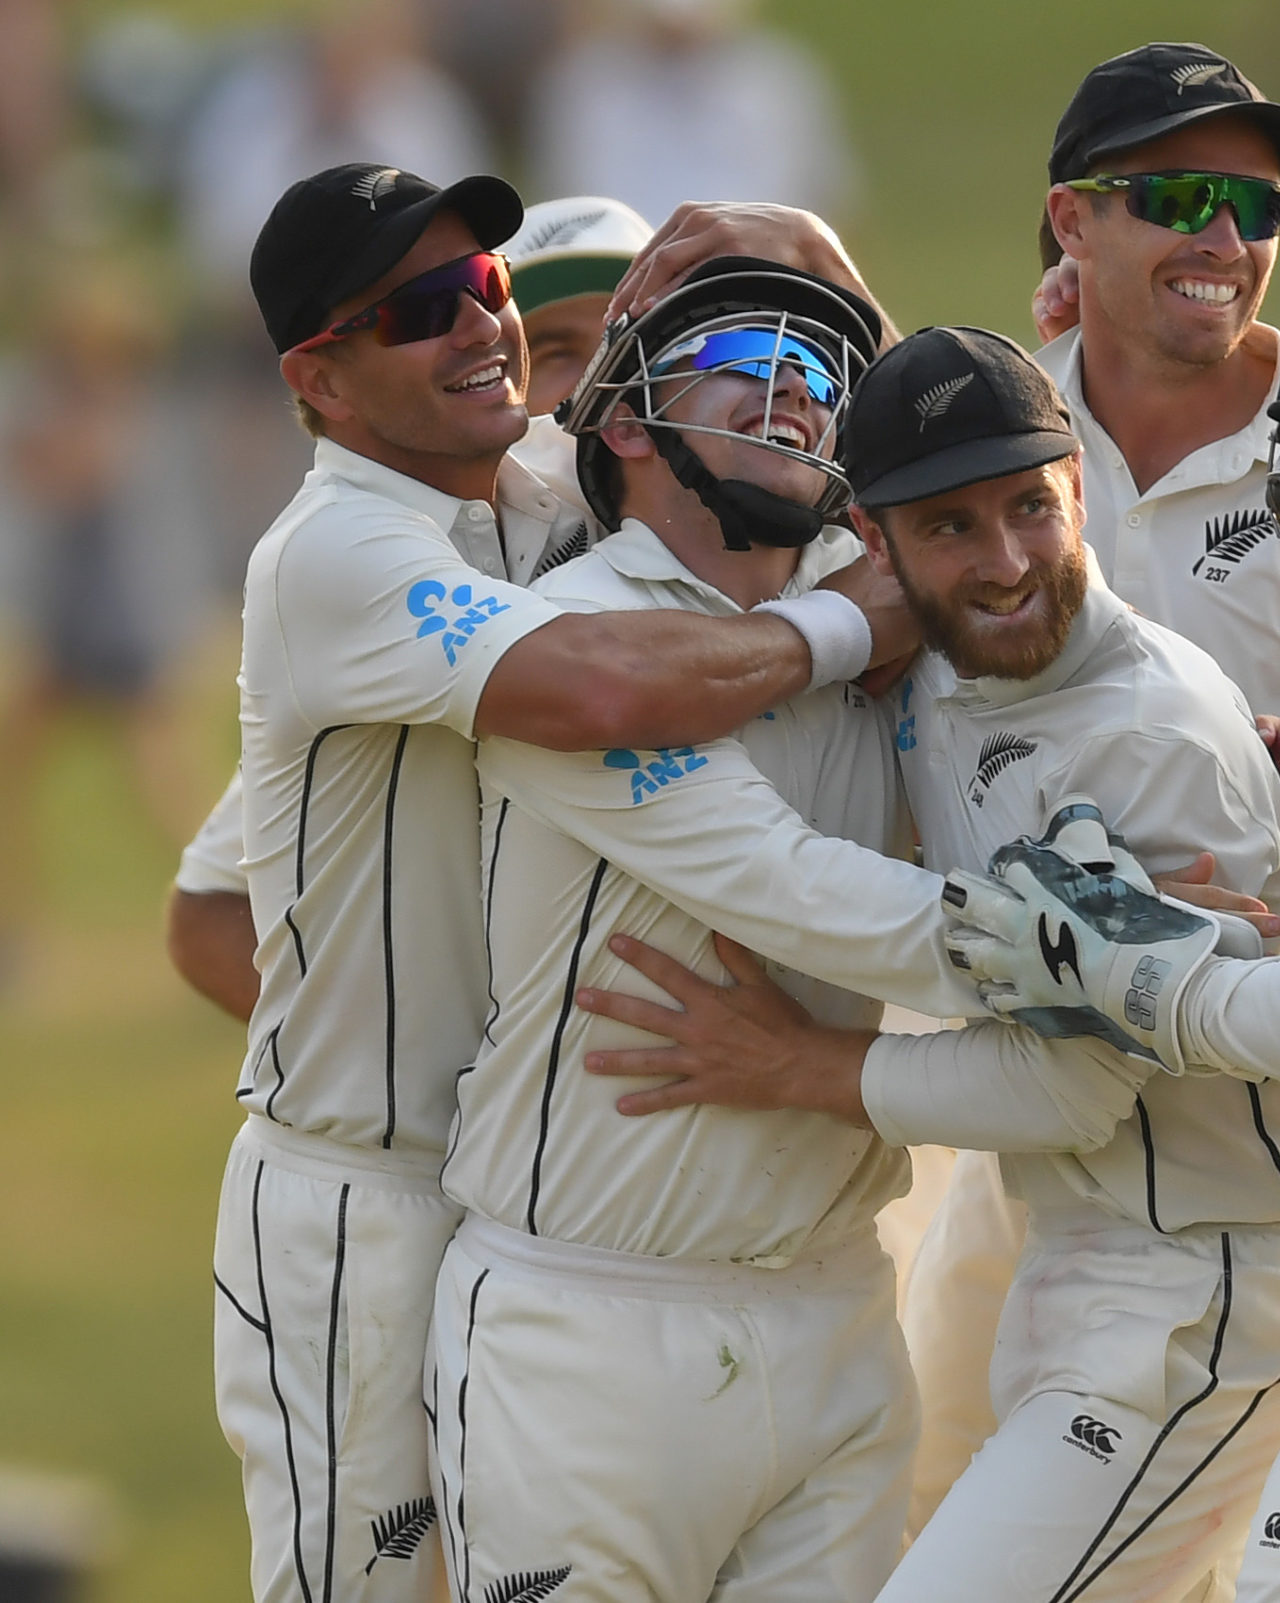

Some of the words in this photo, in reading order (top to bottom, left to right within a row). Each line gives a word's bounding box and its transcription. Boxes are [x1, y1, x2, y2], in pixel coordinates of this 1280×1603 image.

[1205, 567, 1231, 583] 237
[441, 596, 512, 668] ANZ
[631, 747, 709, 805] ANZ
[1062, 1435, 1112, 1466] canterbury
